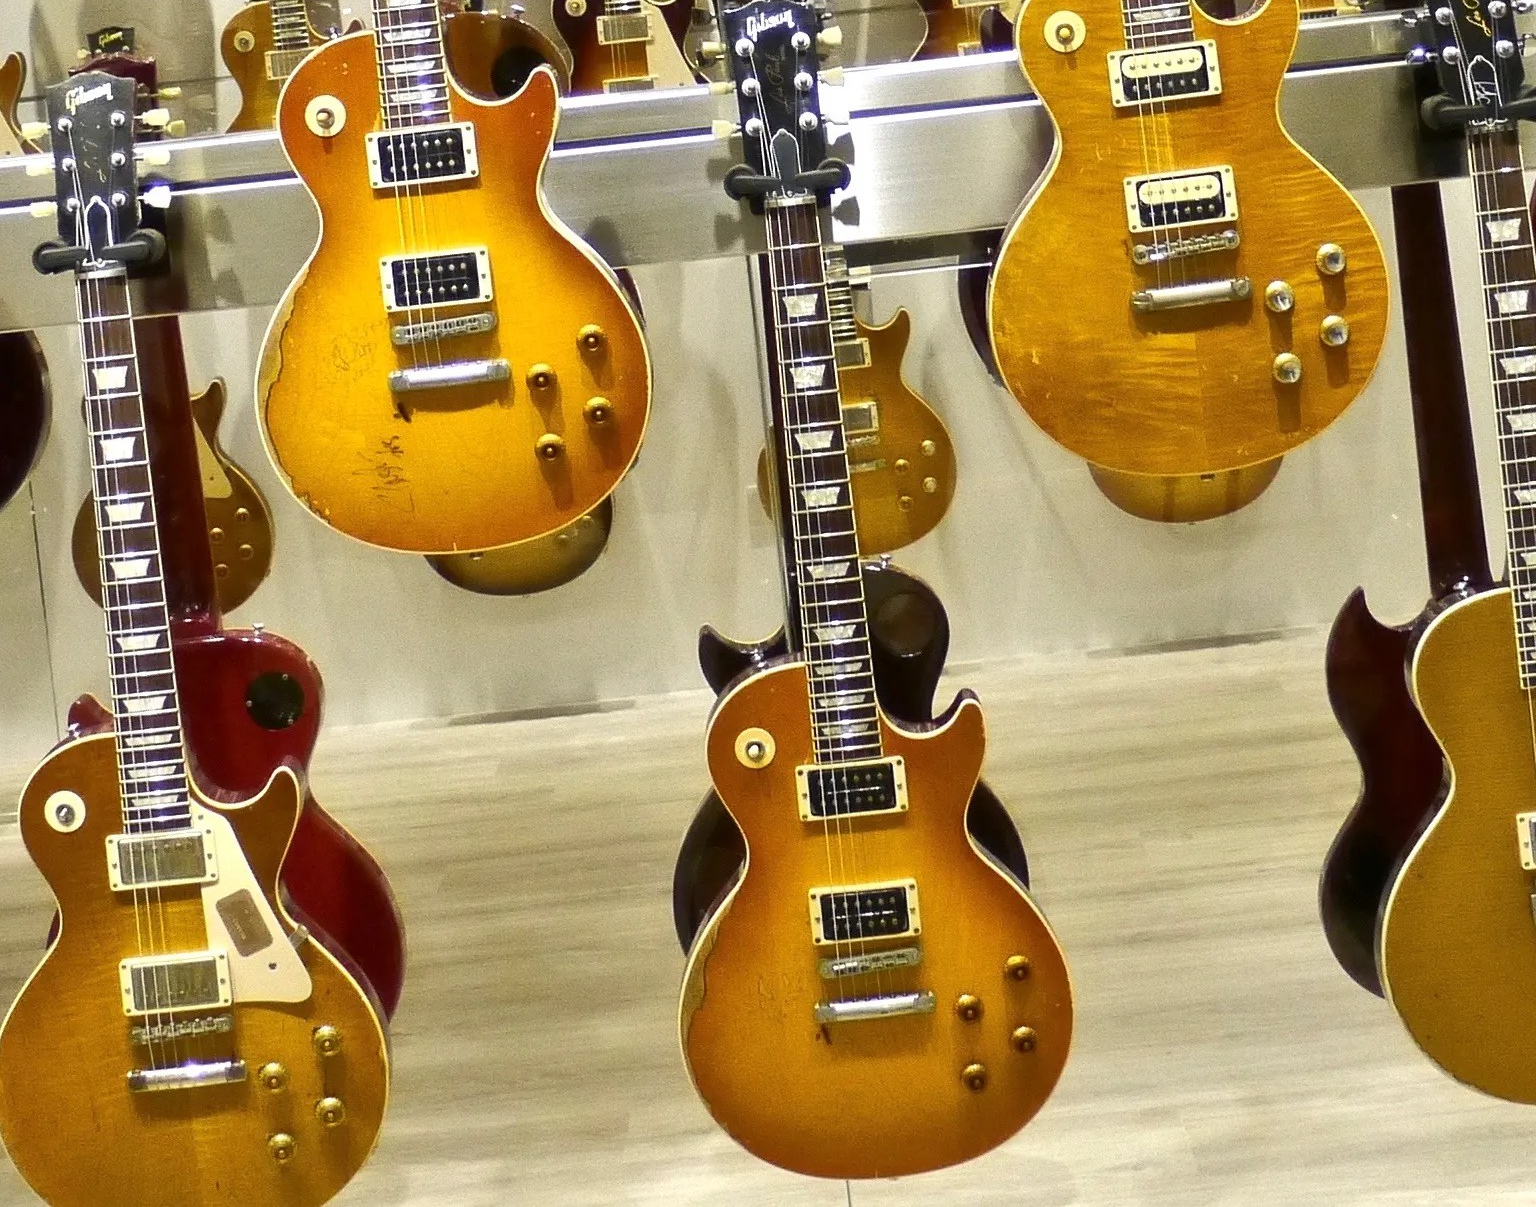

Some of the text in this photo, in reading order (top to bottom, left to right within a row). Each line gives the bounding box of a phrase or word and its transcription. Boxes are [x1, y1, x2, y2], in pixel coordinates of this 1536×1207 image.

[746, 9, 796, 43] Gibson
[1465, 11, 1492, 37] Les
[65, 81, 113, 116] Gibson
